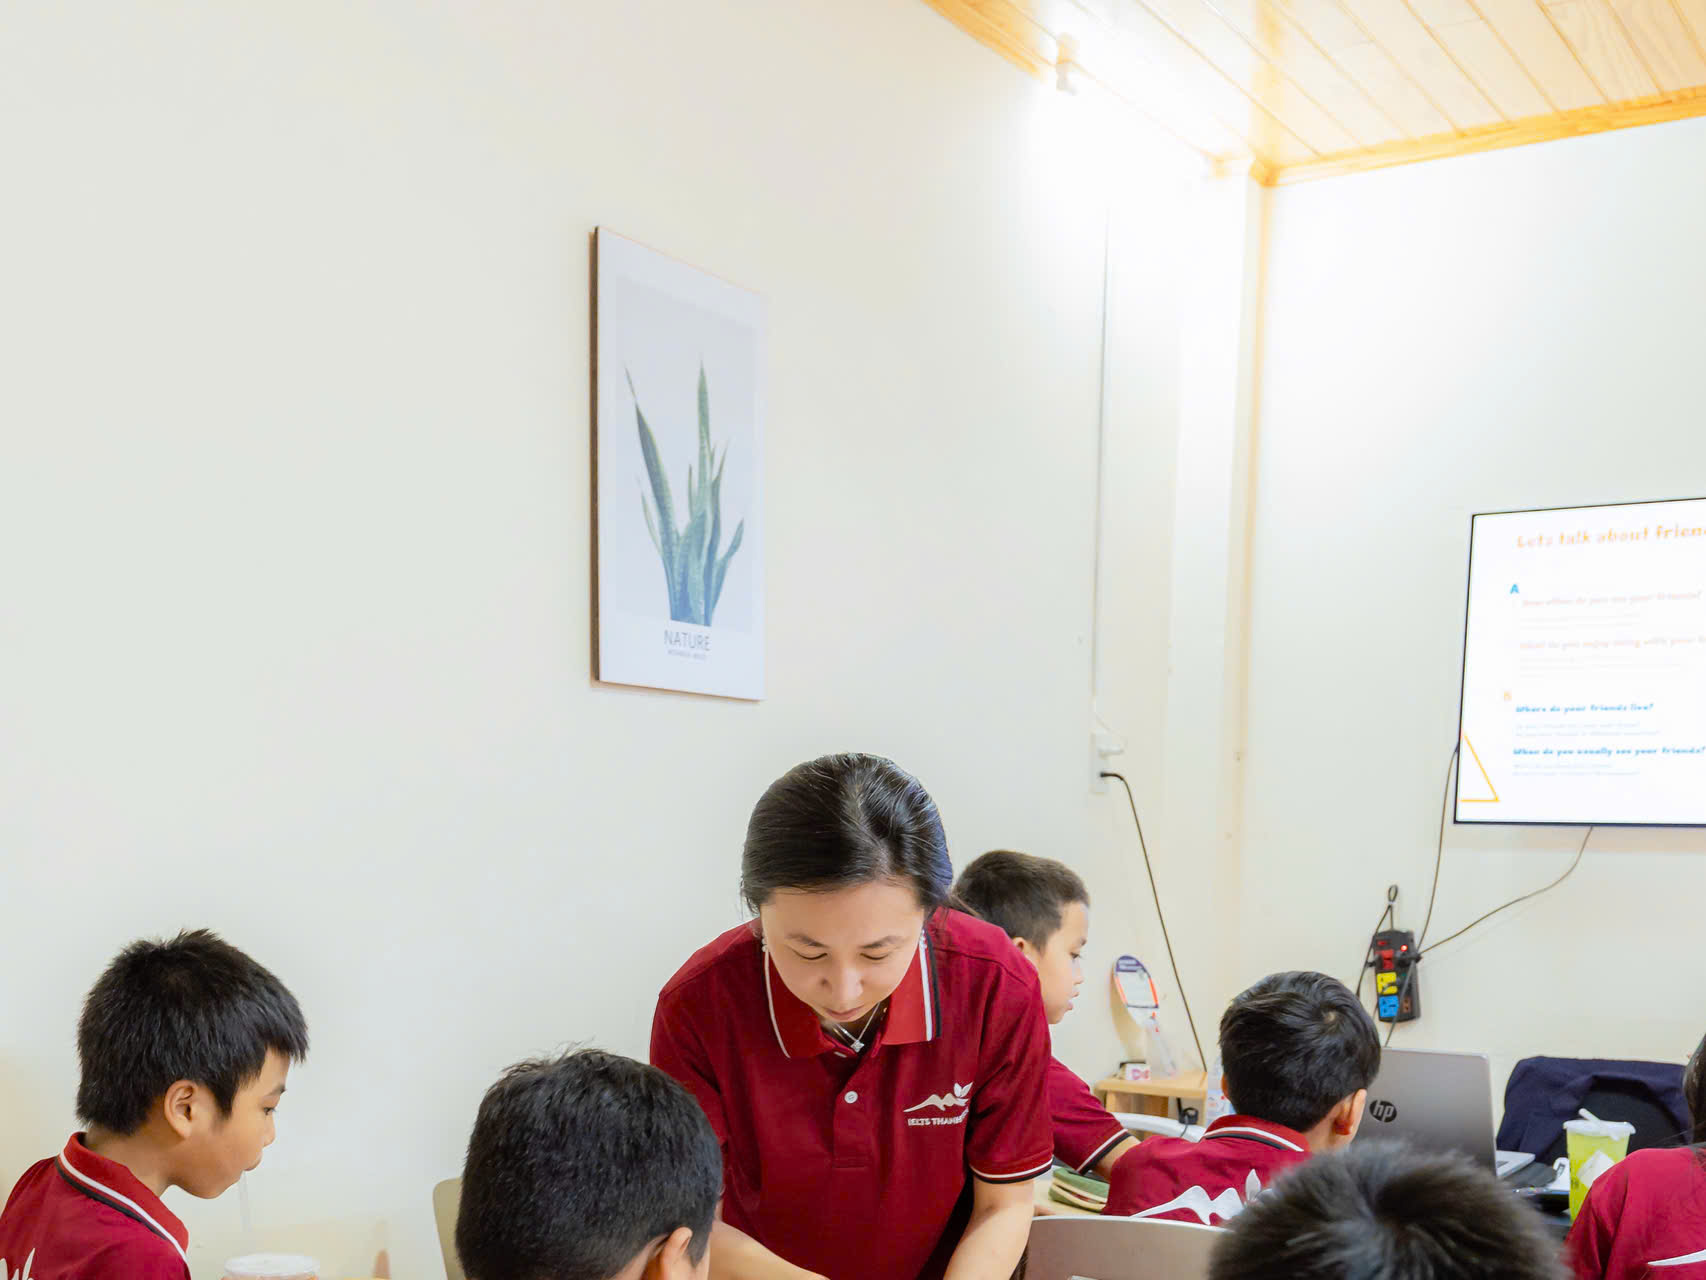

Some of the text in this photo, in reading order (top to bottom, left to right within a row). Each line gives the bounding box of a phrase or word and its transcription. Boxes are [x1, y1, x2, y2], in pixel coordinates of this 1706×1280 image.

[1558, 529, 1591, 545] talk
[1597, 526, 1649, 544] about
[1656, 522, 1706, 540] frien
[1510, 583, 1520, 594] A
[664, 629, 711, 651] NATURE
[907, 1118, 931, 1126] IELTS
[1371, 1100, 1396, 1122] hp
